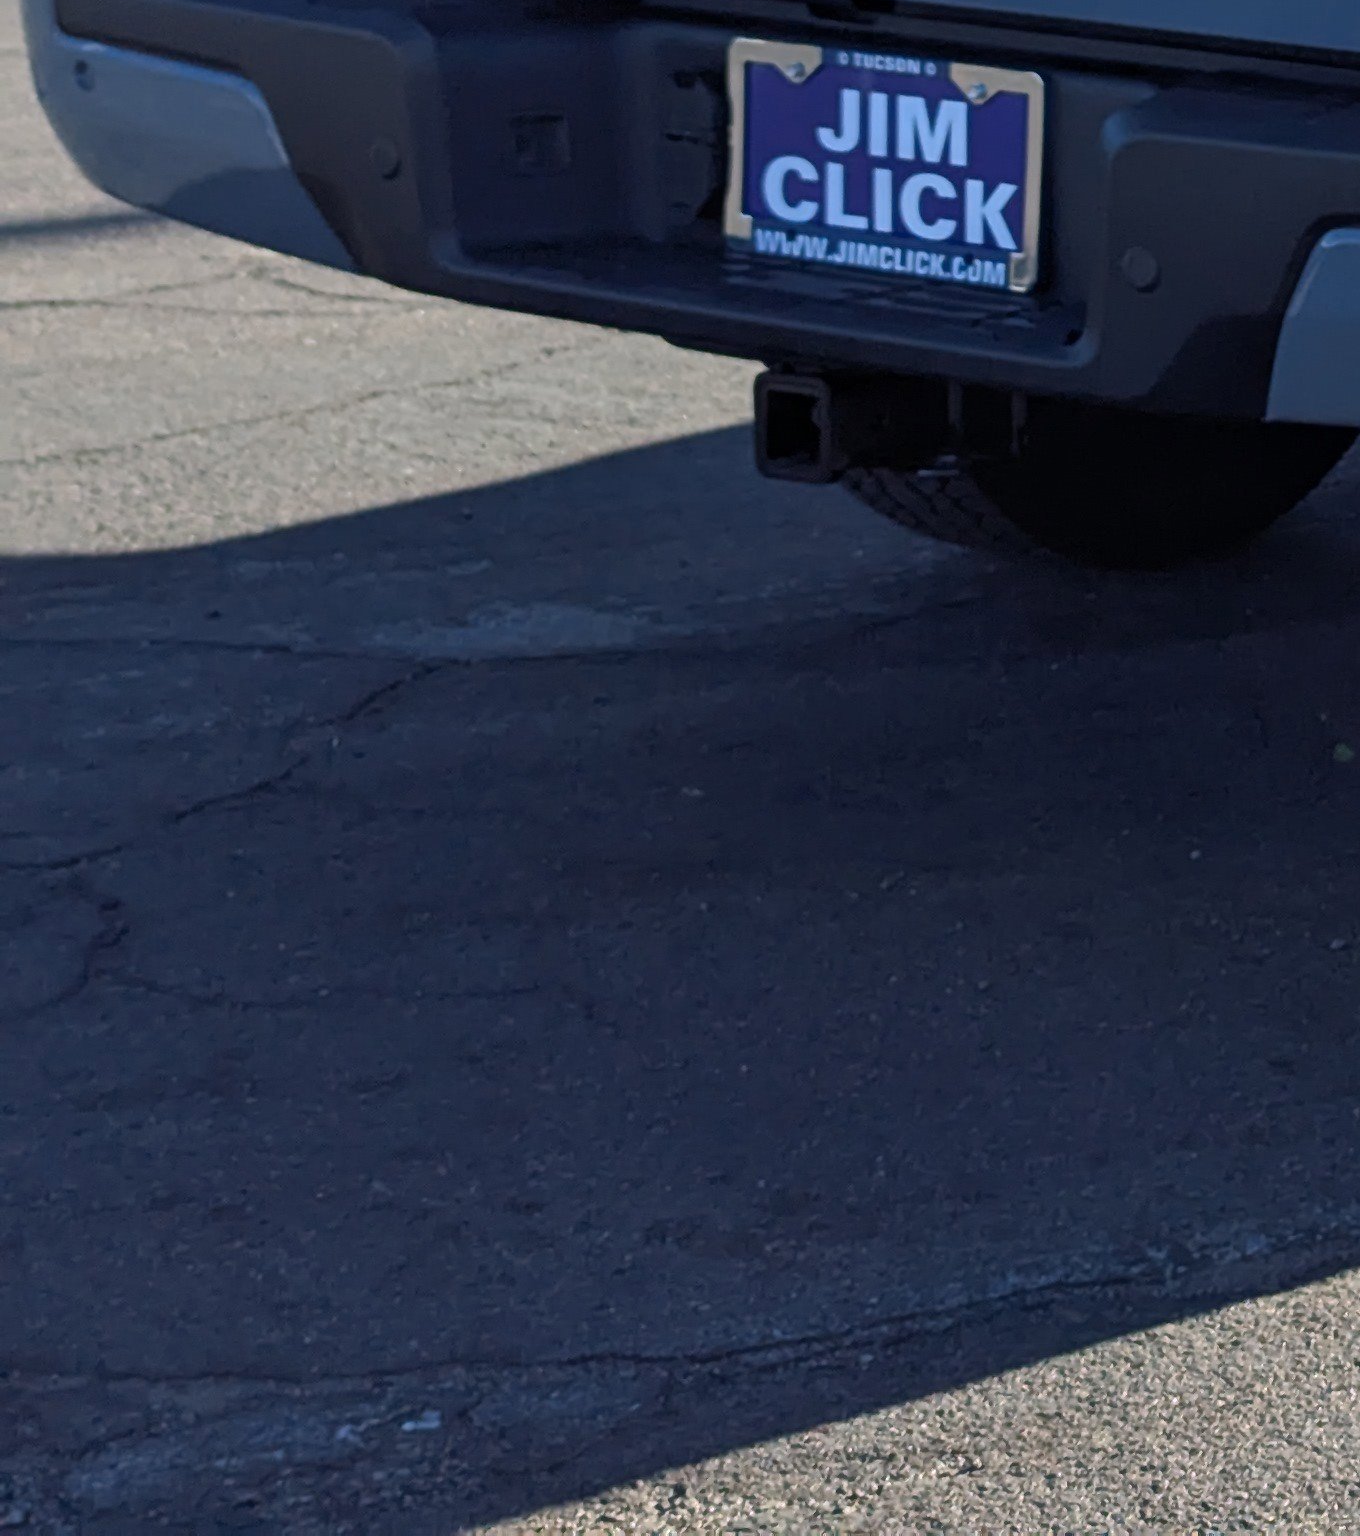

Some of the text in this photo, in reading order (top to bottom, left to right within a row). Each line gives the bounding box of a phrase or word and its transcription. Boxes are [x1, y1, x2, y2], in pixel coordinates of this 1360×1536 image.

[853, 51, 921, 75] TUCSON
[816, 87, 969, 167] JIM
[762, 155, 1019, 251] CLICK
[755, 228, 1007, 287] WWW.JIMCLICK.COM
